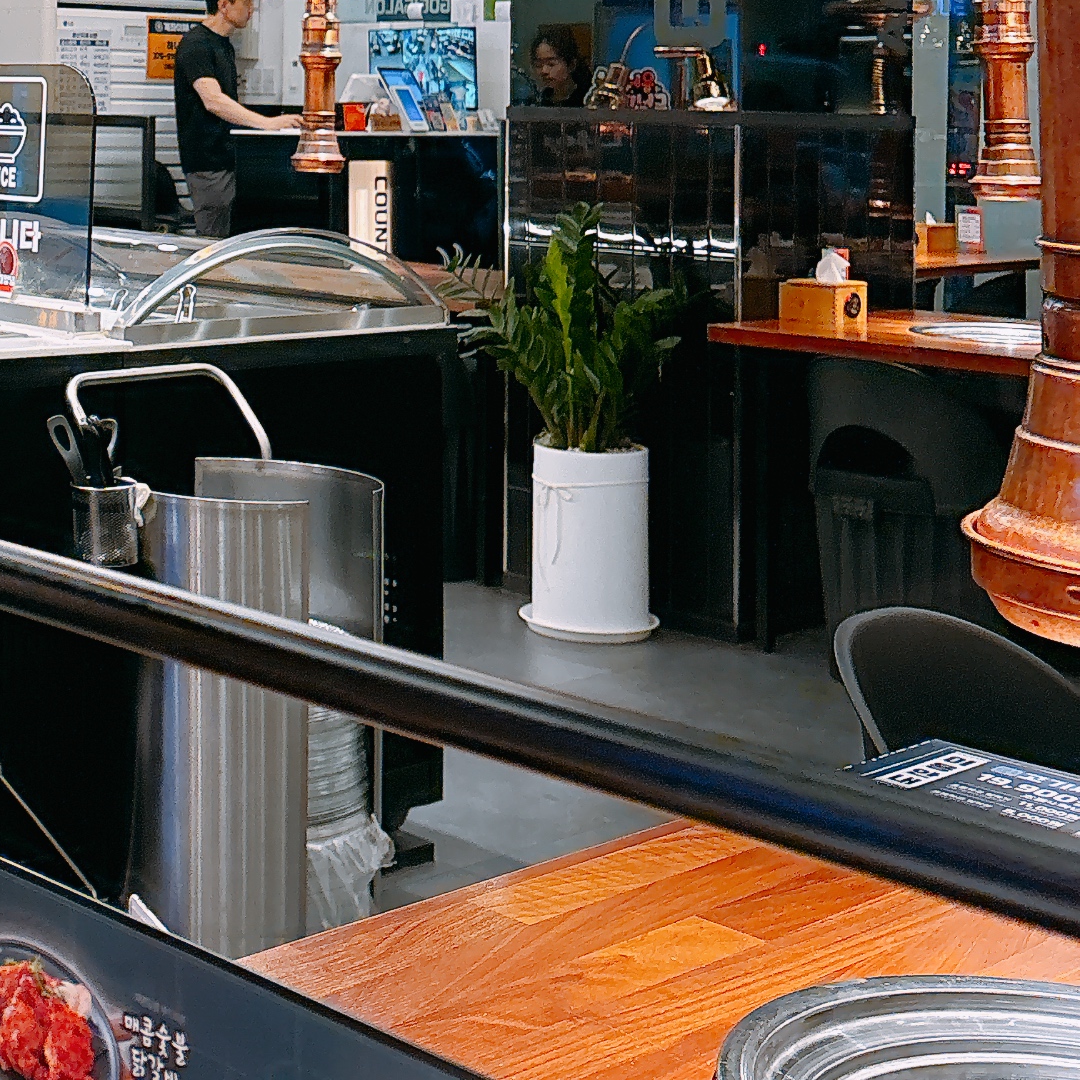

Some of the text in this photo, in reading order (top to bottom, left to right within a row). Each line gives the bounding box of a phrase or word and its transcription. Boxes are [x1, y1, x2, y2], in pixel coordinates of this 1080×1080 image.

[374, 176, 388, 248] COUN
[977, 771, 1080, 805] 19,900
[124, 1015, 189, 1067] 매콤숯불
